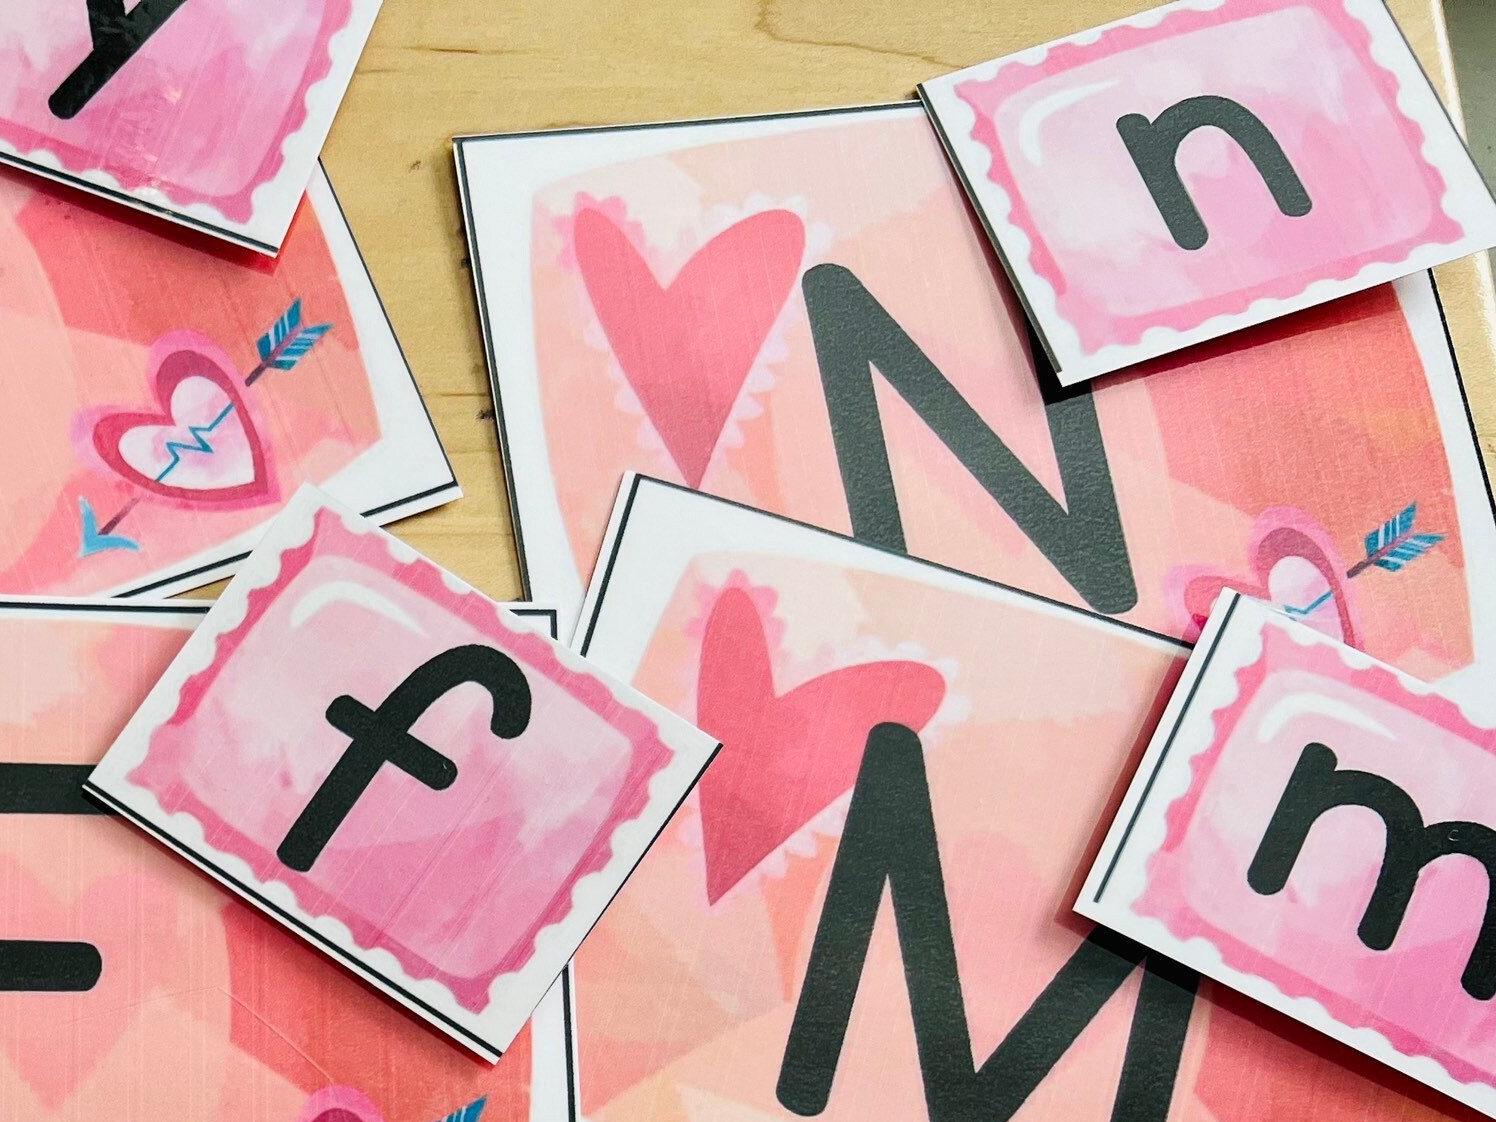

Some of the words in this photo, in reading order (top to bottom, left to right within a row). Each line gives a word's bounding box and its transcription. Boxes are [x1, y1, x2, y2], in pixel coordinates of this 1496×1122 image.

[1116, 95, 1312, 250] n
[802, 264, 1139, 614] N
[277, 643, 532, 872] f
[1247, 742, 1496, 1001] m
